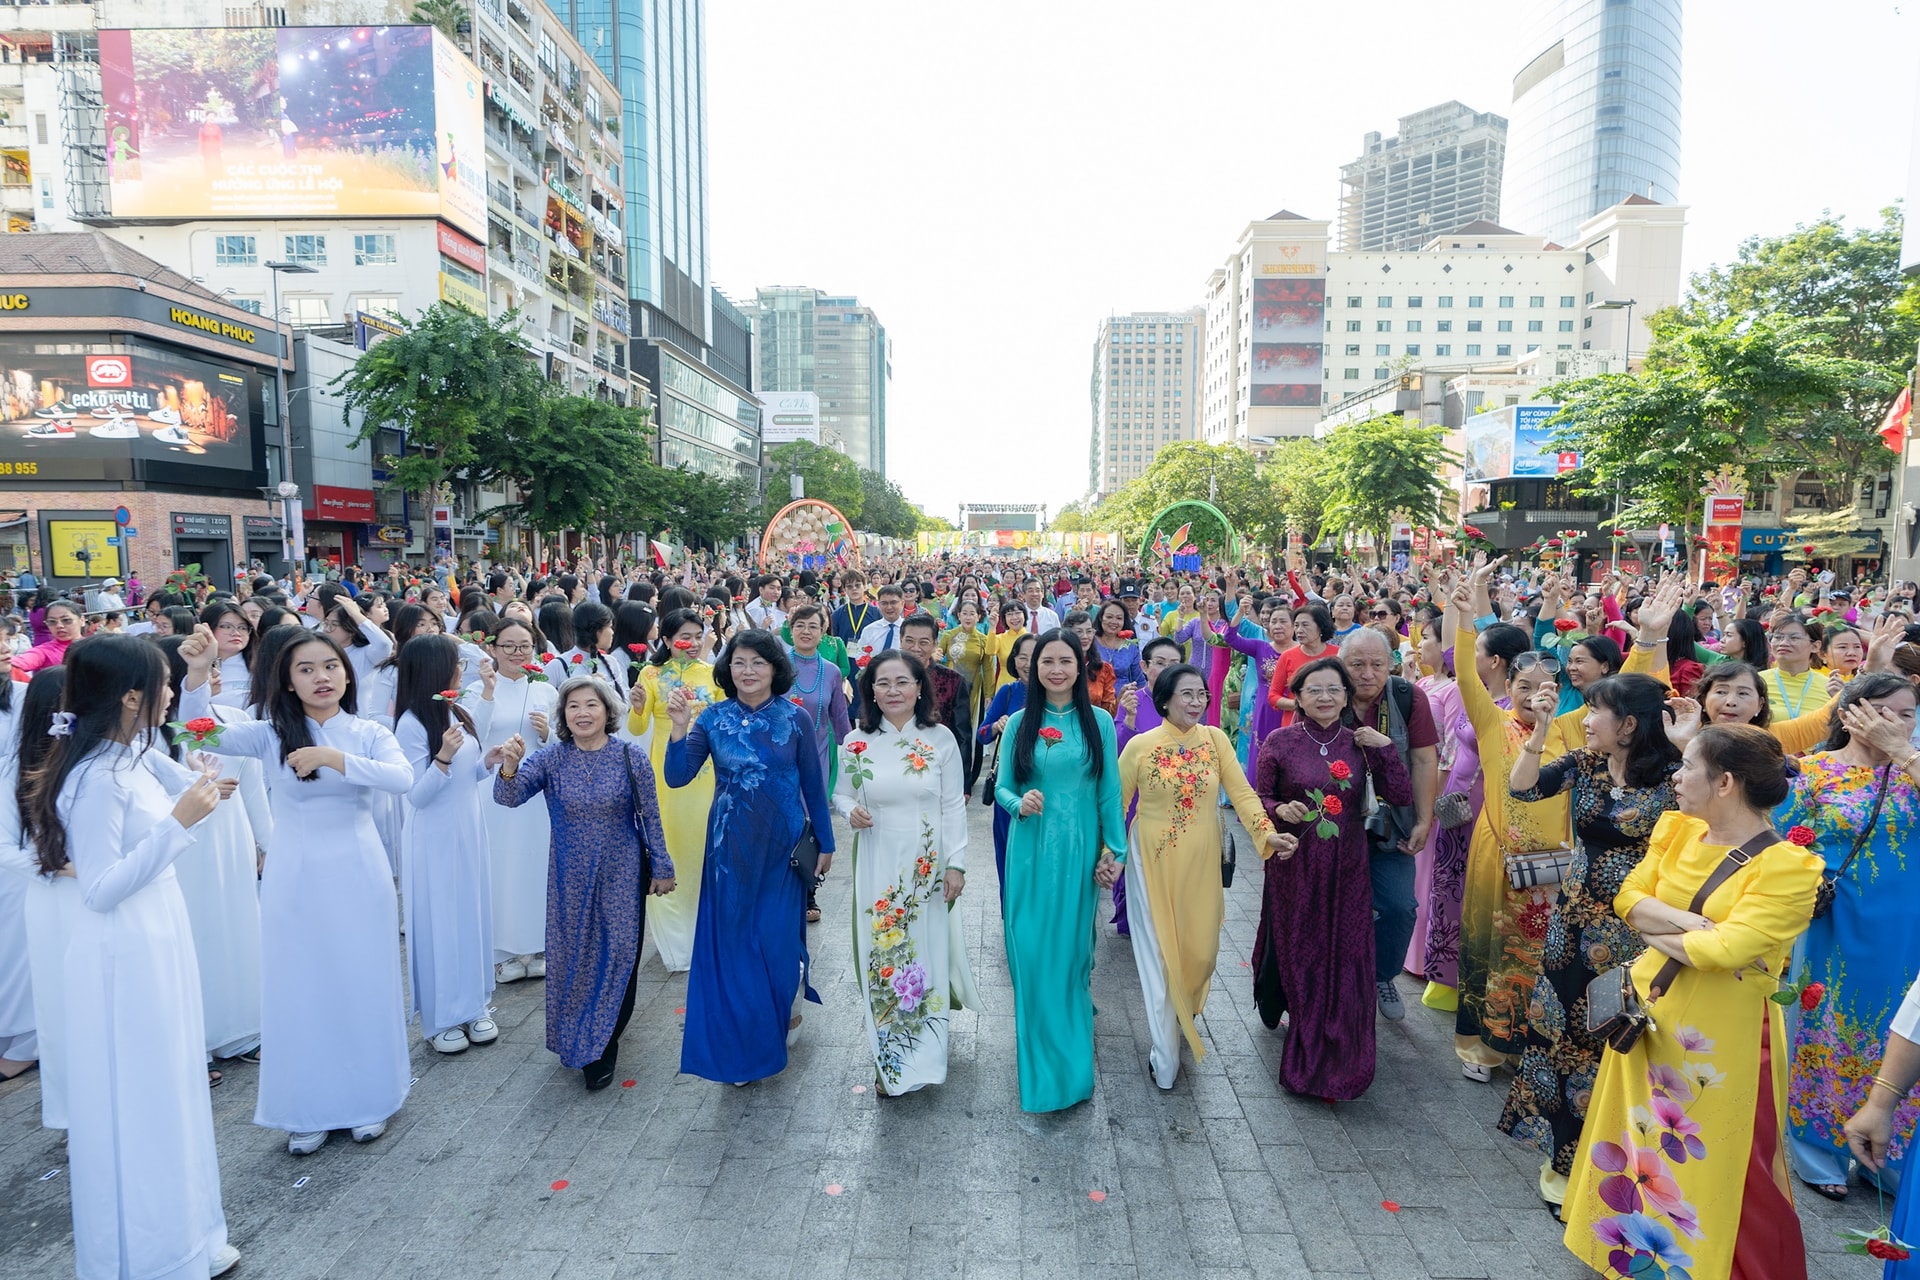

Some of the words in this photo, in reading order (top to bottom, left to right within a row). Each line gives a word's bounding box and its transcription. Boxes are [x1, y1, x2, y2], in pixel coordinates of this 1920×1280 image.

[299, 163, 323, 176] THI
[171, 306, 220, 334] HOANG
[221, 322, 256, 344] PHUC
[72, 390, 106, 407] ecko
[1533, 409, 1551, 417] CÙNG
[15, 462, 38, 475] 955
